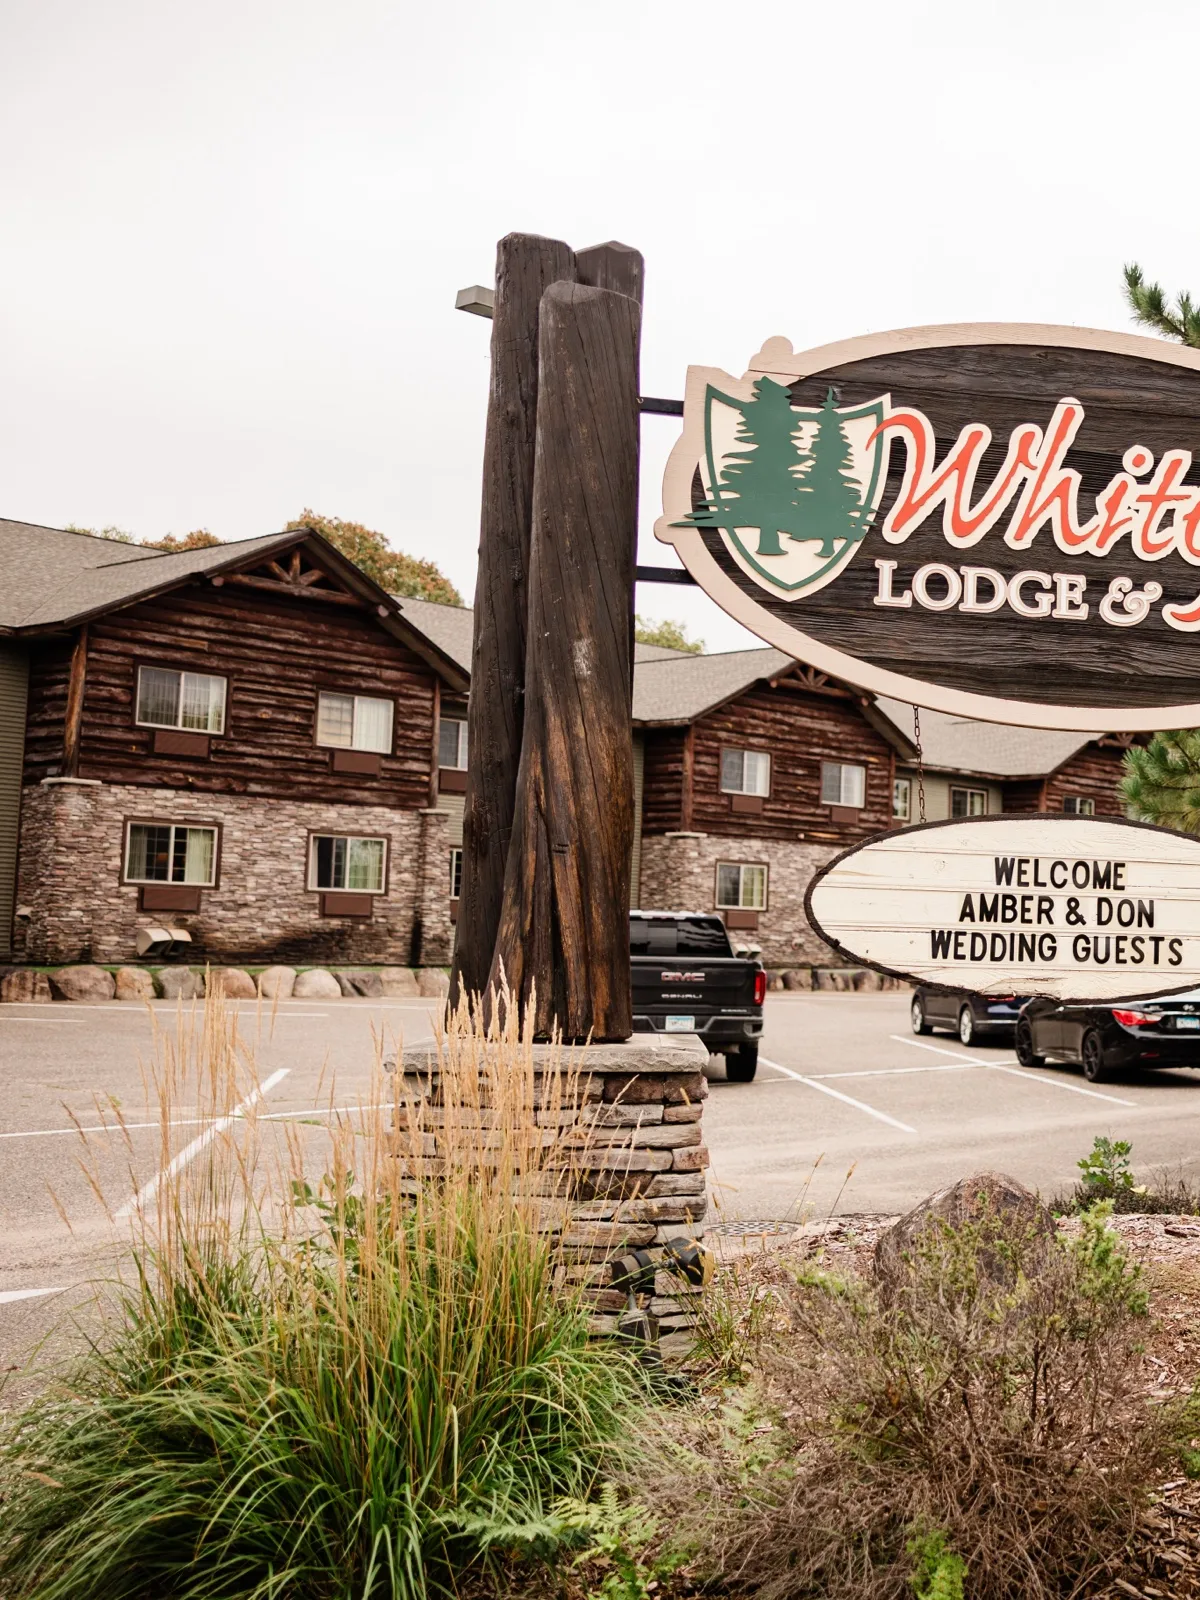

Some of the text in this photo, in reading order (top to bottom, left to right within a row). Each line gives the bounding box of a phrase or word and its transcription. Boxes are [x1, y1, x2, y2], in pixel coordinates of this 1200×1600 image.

[874, 559, 1089, 620] LODGE
[1099, 575, 1163, 626] &
[994, 857, 1126, 890] WELCOME
[959, 893, 1155, 928] AMBER & DON
[930, 929, 1183, 966] WEDDING GUESTS
[661, 972, 705, 981] GMC
